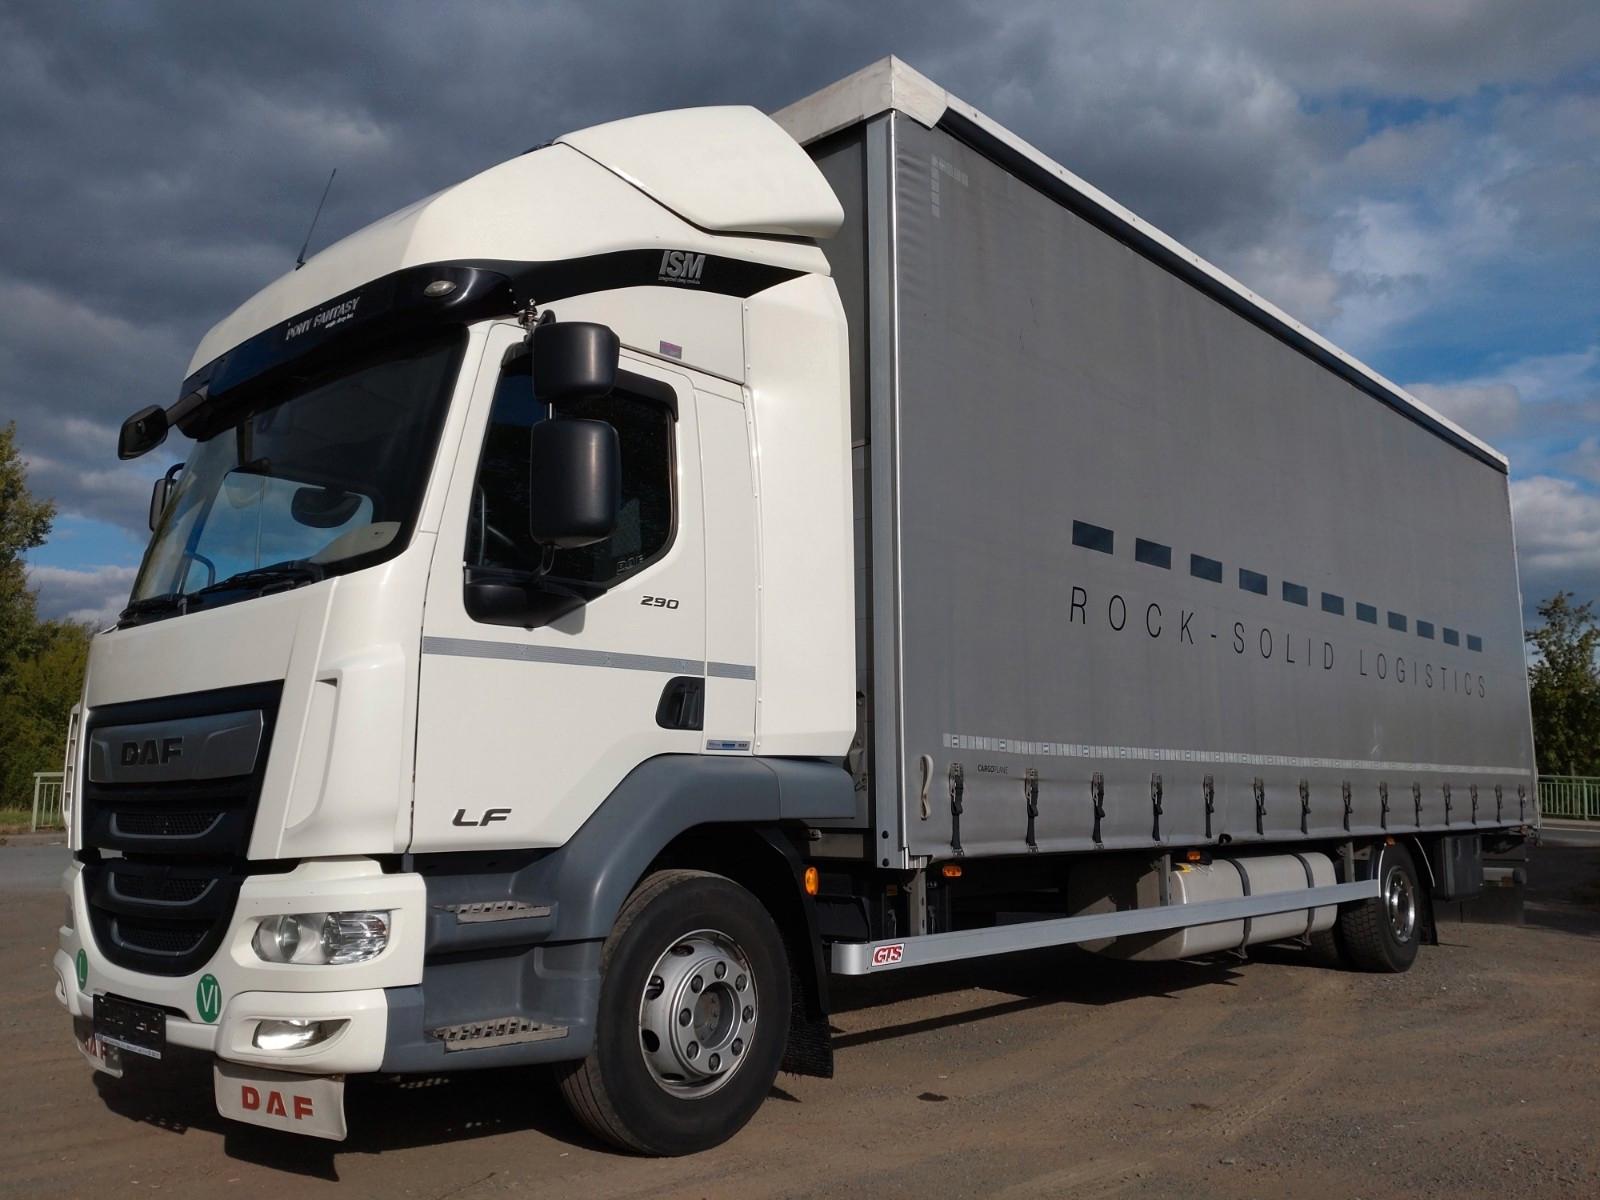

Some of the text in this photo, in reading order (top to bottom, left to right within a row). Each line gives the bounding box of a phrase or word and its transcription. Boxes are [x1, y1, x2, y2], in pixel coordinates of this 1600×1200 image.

[659, 250, 706, 279] ISM
[312, 296, 361, 328] FANTASY
[640, 595, 680, 610] 290
[1359, 648, 1486, 699] LOGISTICS
[120, 736, 184, 767] DAF
[452, 808, 512, 827] LF
[874, 945, 903, 964] GTS
[200, 982, 218, 1015] VI
[241, 1085, 313, 1121] DAF
